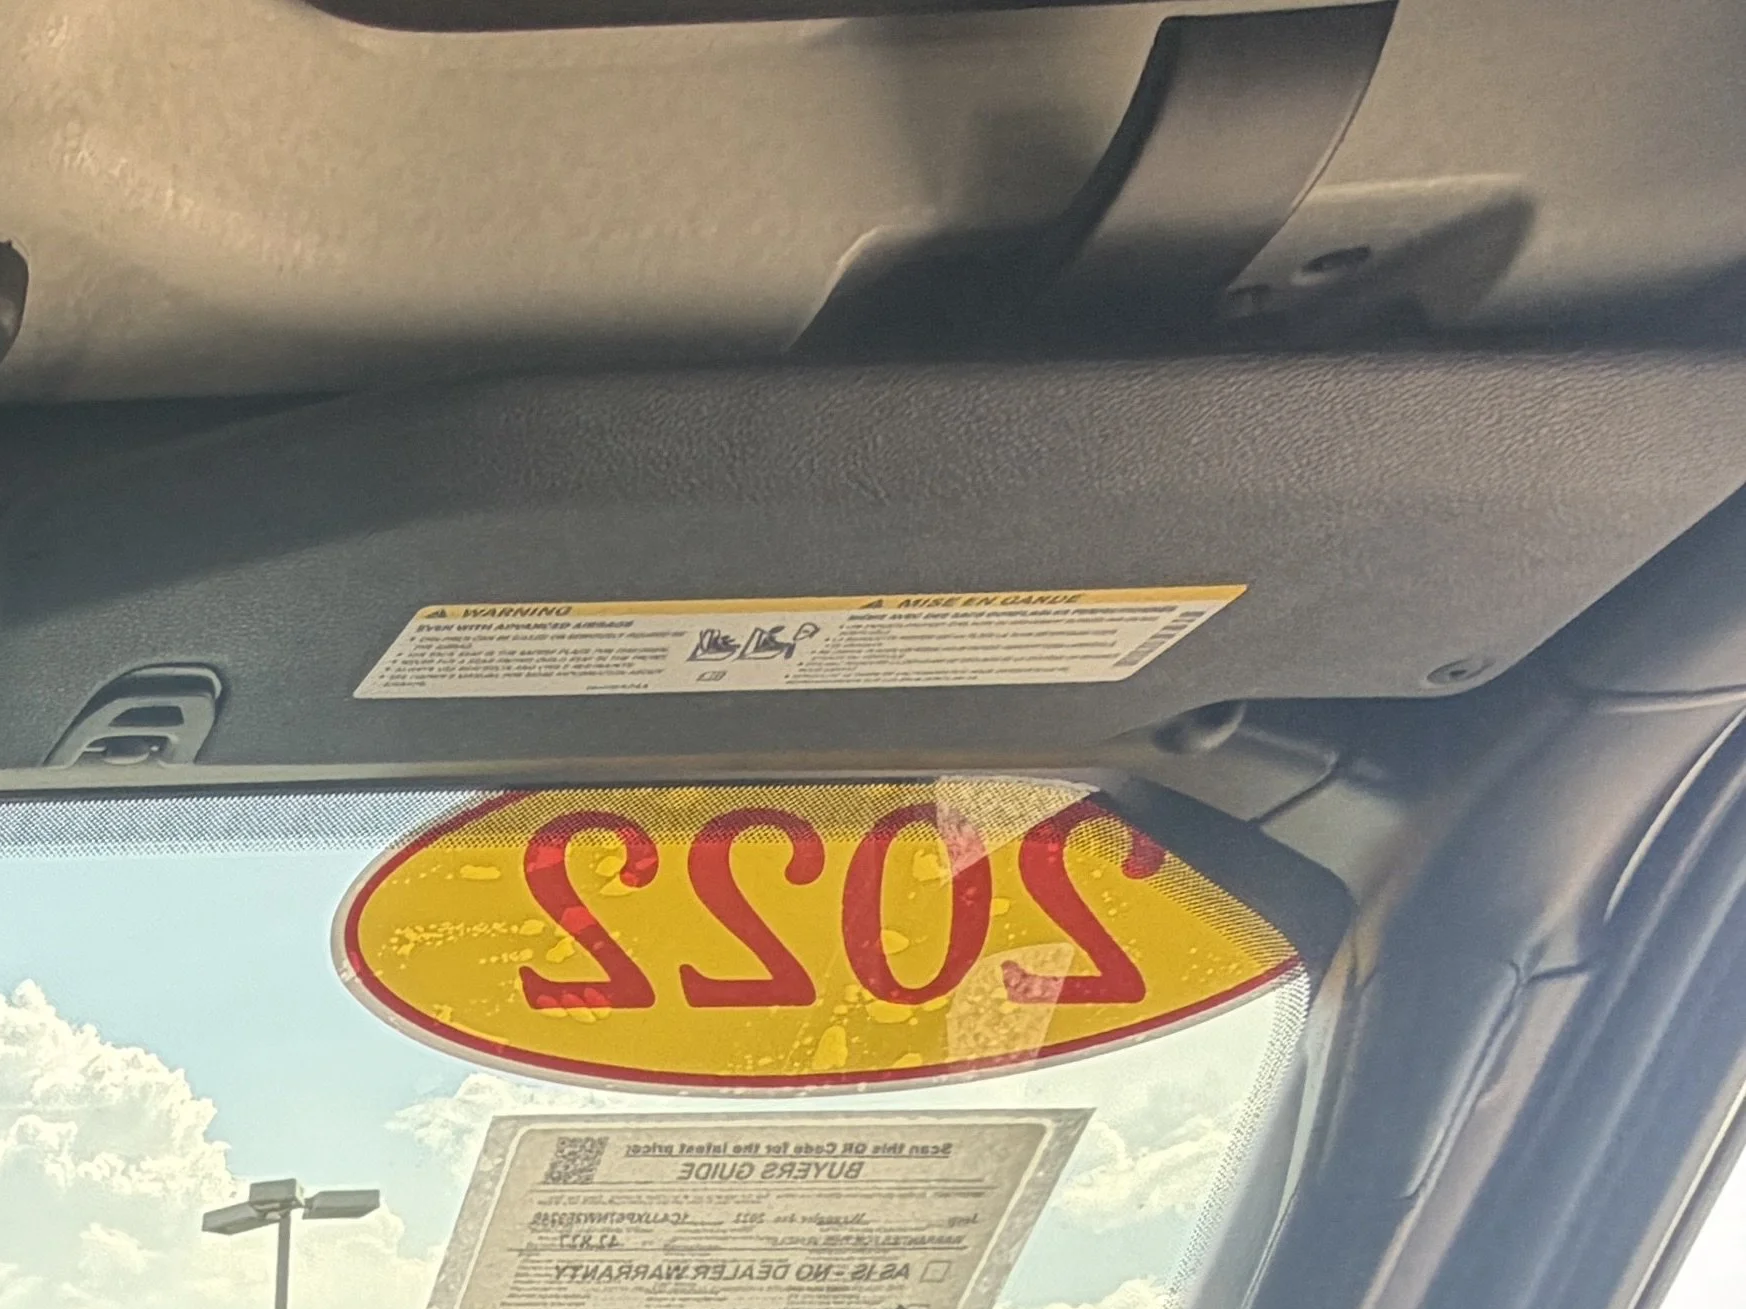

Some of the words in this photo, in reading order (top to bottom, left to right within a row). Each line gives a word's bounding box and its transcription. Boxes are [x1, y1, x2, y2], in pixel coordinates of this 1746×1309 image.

[898, 596, 960, 608] MISE
[965, 596, 996, 607] EN
[1002, 594, 1083, 605] GARDE
[461, 605, 572, 618] WARNING
[416, 623, 454, 633] EVEN
[456, 623, 492, 632] WITH
[495, 621, 570, 631] ADVANCED
